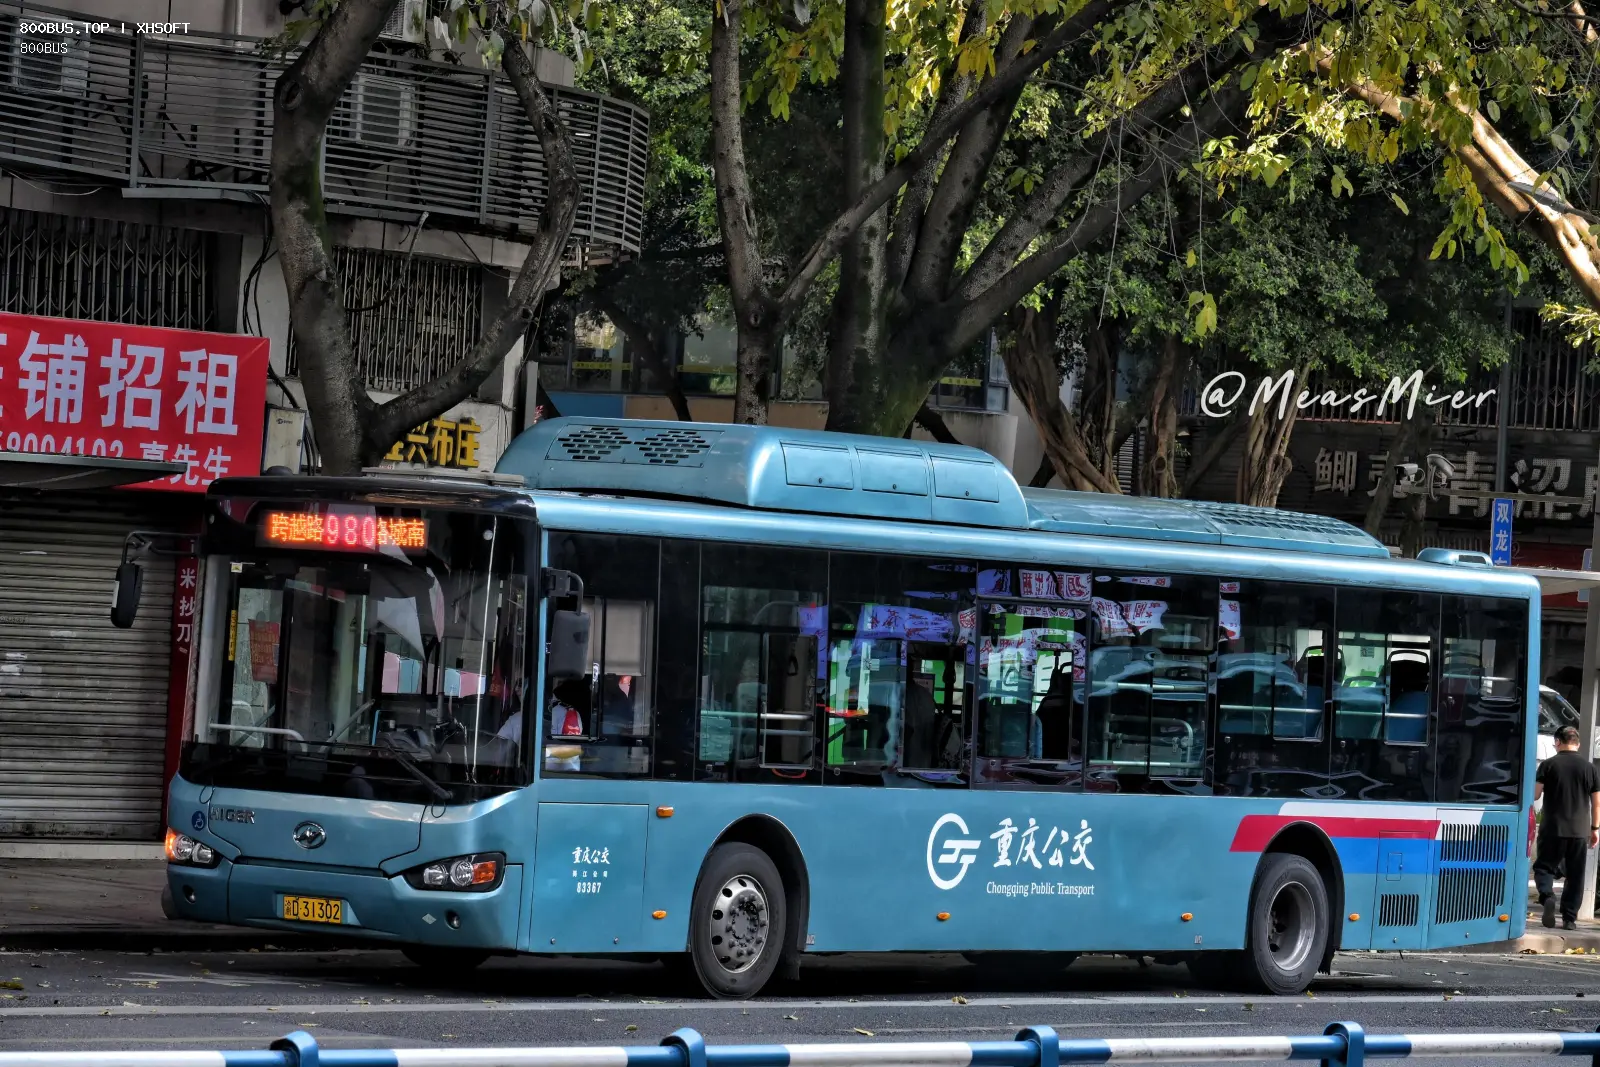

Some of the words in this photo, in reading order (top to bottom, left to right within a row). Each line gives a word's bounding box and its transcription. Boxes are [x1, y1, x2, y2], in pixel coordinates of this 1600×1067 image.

[0, 330, 238, 436] 铺招租
[0, 430, 124, 459] 8004102
[271, 512, 324, 542] 跨越路
[327, 514, 376, 546] 980
[1494, 502, 1511, 566] 双龙
[572, 846, 610, 865] 重庆公交
[989, 817, 1095, 871] 重庆公交
[576, 882, 602, 893] 83367
[986, 881, 1029, 898] Chongqing
[1031, 882, 1055, 895] Public
[1057, 882, 1095, 898] Transport
